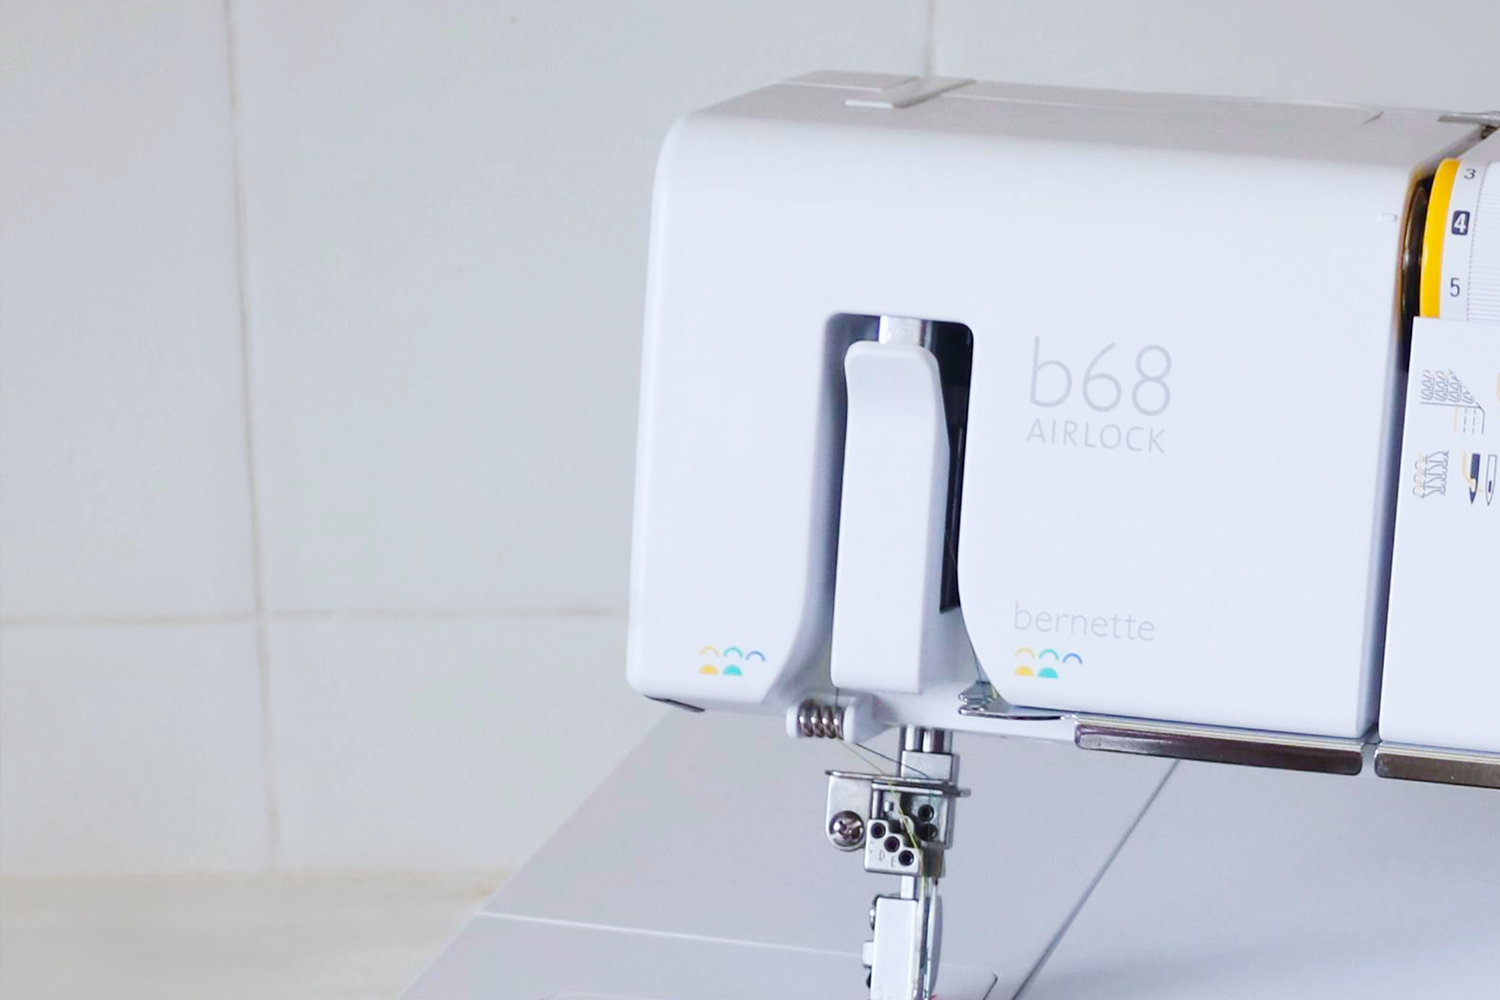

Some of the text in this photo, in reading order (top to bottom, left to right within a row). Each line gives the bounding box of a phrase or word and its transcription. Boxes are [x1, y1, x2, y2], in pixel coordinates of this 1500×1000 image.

[1464, 169, 1476, 179] 3
[1455, 214, 1468, 233] 4
[1450, 278, 1460, 297] 5
[1030, 336, 1172, 416] b68
[1027, 418, 1165, 453] AIRLOCK
[1014, 601, 1155, 641] bernette
